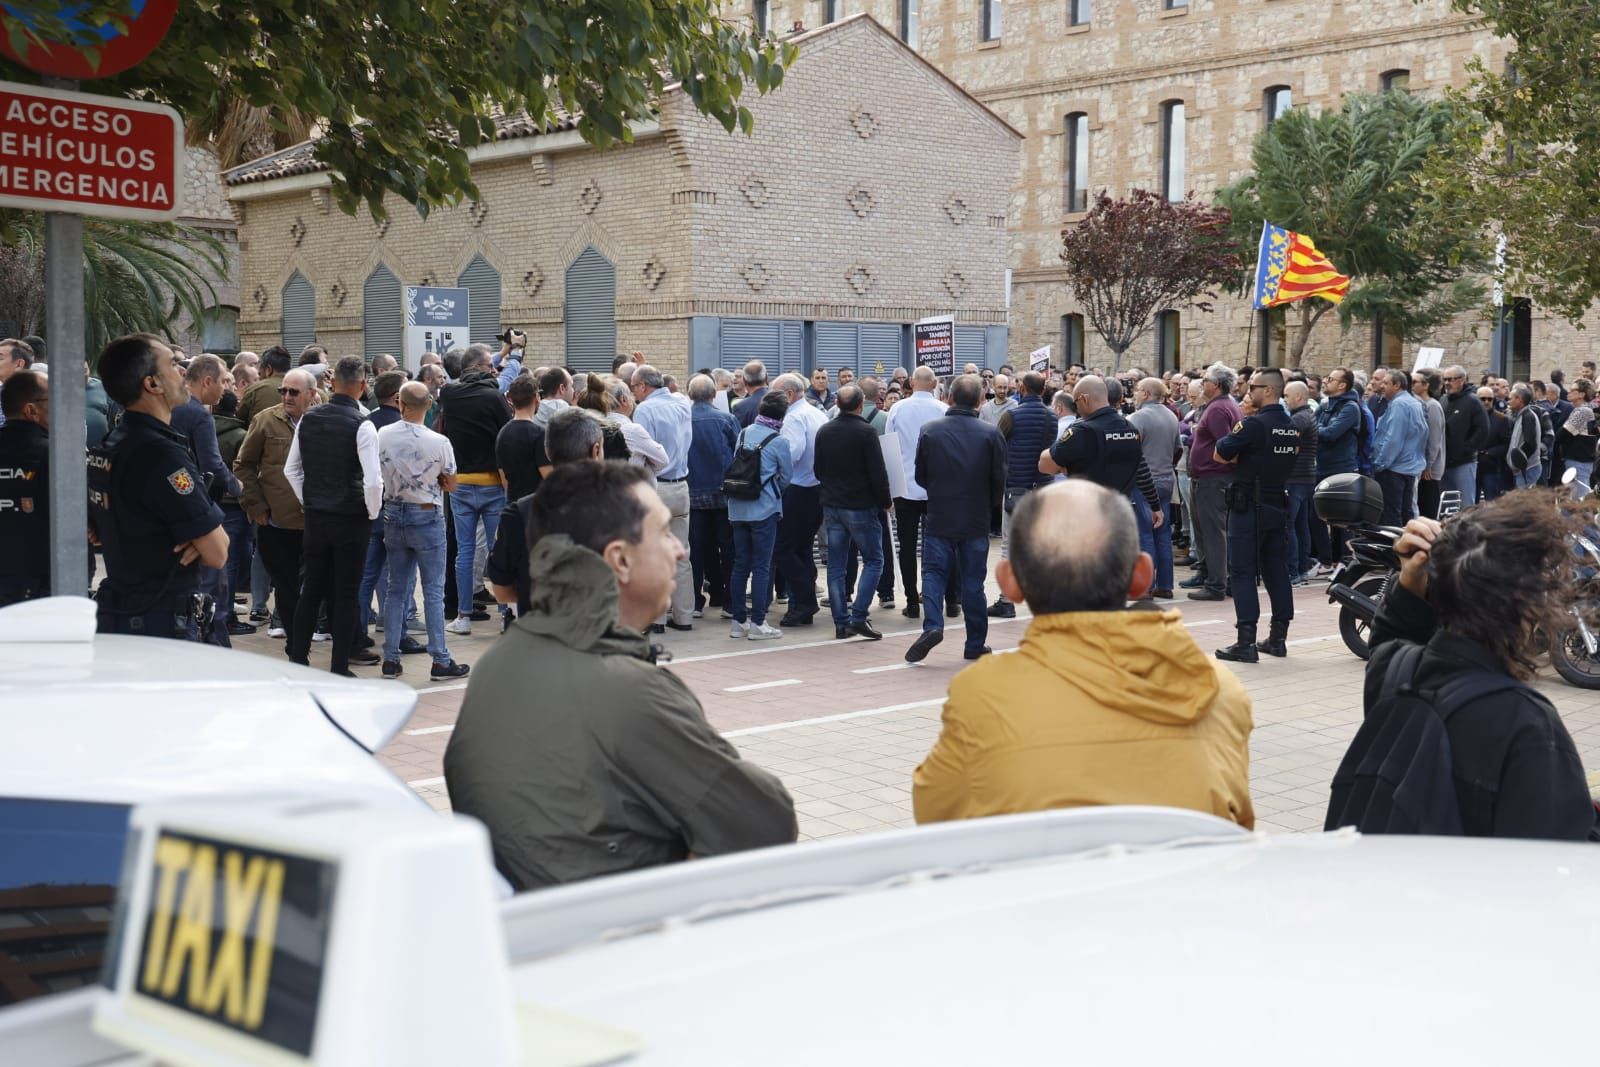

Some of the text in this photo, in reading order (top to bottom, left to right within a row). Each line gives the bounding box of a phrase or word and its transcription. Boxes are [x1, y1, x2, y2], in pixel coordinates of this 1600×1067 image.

[6, 99, 132, 136] ACCESO
[1, 132, 156, 171] EHÍCULOS
[0, 165, 169, 205] ERGENCIA
[0, 467, 26, 479] CIA
[143, 836, 286, 1029] TAXI
